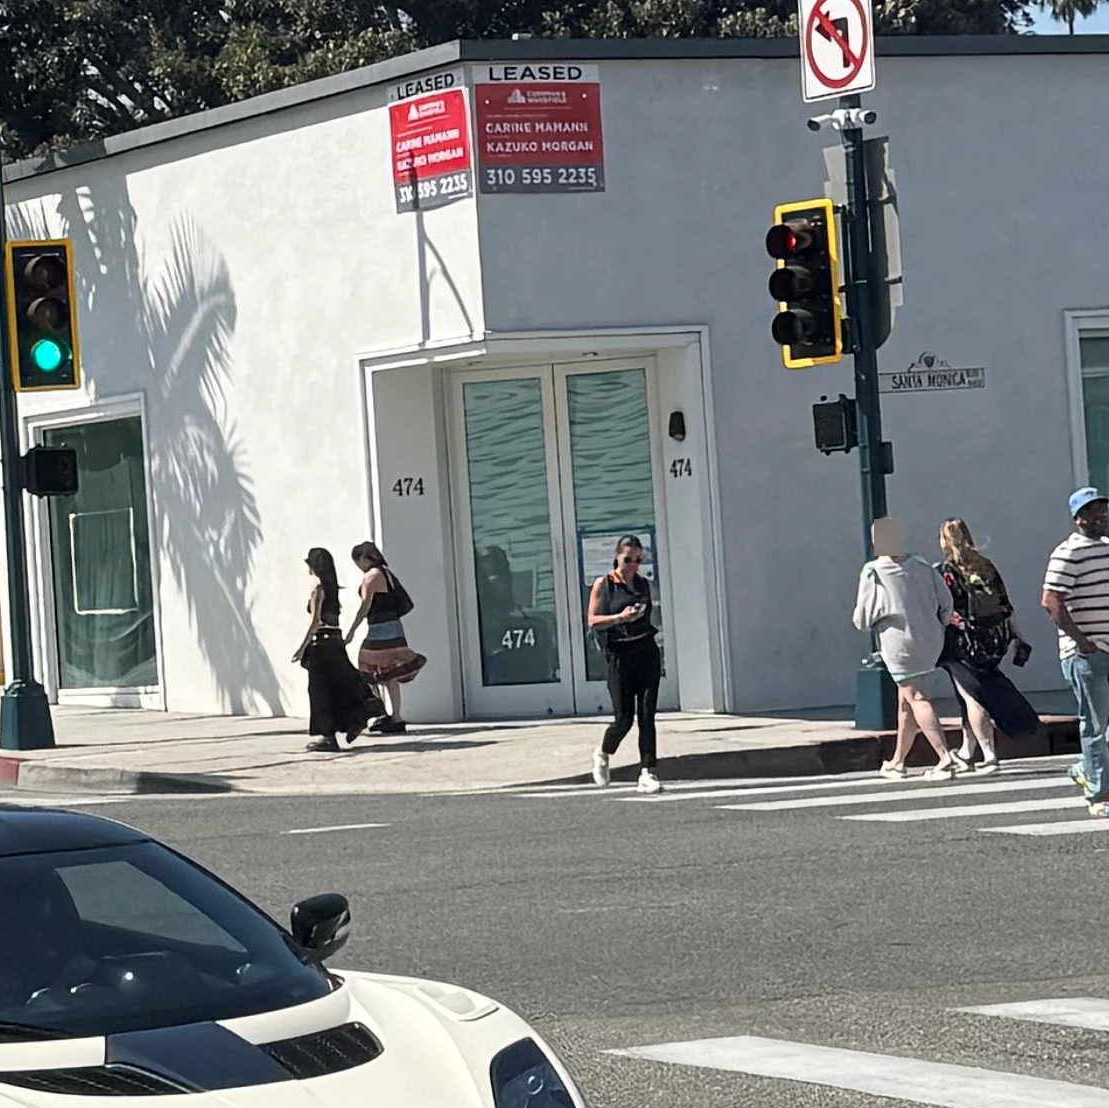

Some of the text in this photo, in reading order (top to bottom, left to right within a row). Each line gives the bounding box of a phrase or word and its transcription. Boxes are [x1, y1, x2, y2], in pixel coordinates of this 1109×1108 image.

[489, 66, 582, 81] LEASED
[396, 73, 455, 100] LEASED
[485, 122, 532, 134] CARINE
[486, 141, 594, 153] KAZUKO MORGAN
[440, 173, 468, 195] 2235
[487, 168, 597, 185] 310 595 2235
[892, 373, 923, 389] SANTA
[927, 371, 967, 388] MONICA
[670, 458, 692, 477] 474
[392, 477, 424, 496] 474
[502, 629, 535, 649] 474
